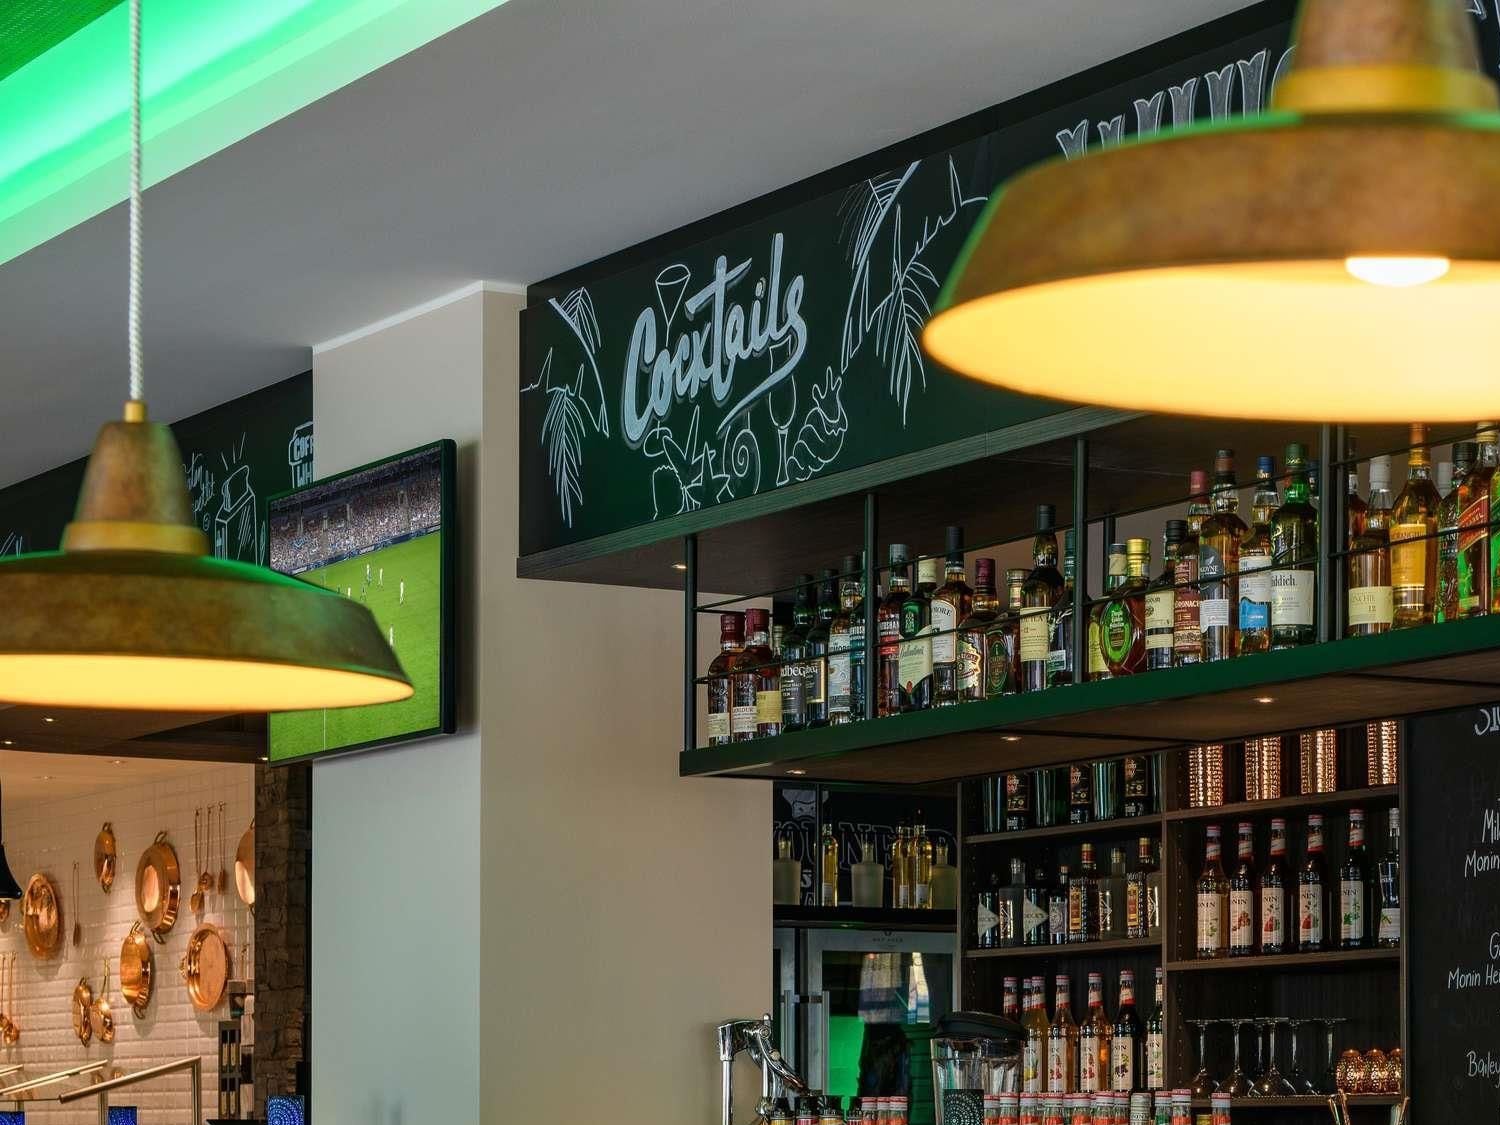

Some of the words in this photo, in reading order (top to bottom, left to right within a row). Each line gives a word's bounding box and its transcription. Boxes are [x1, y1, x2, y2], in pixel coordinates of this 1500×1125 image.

[621, 232, 806, 449] Cocktails
[1464, 850, 1500, 878] Monin
[1447, 967, 1481, 989] Monin
